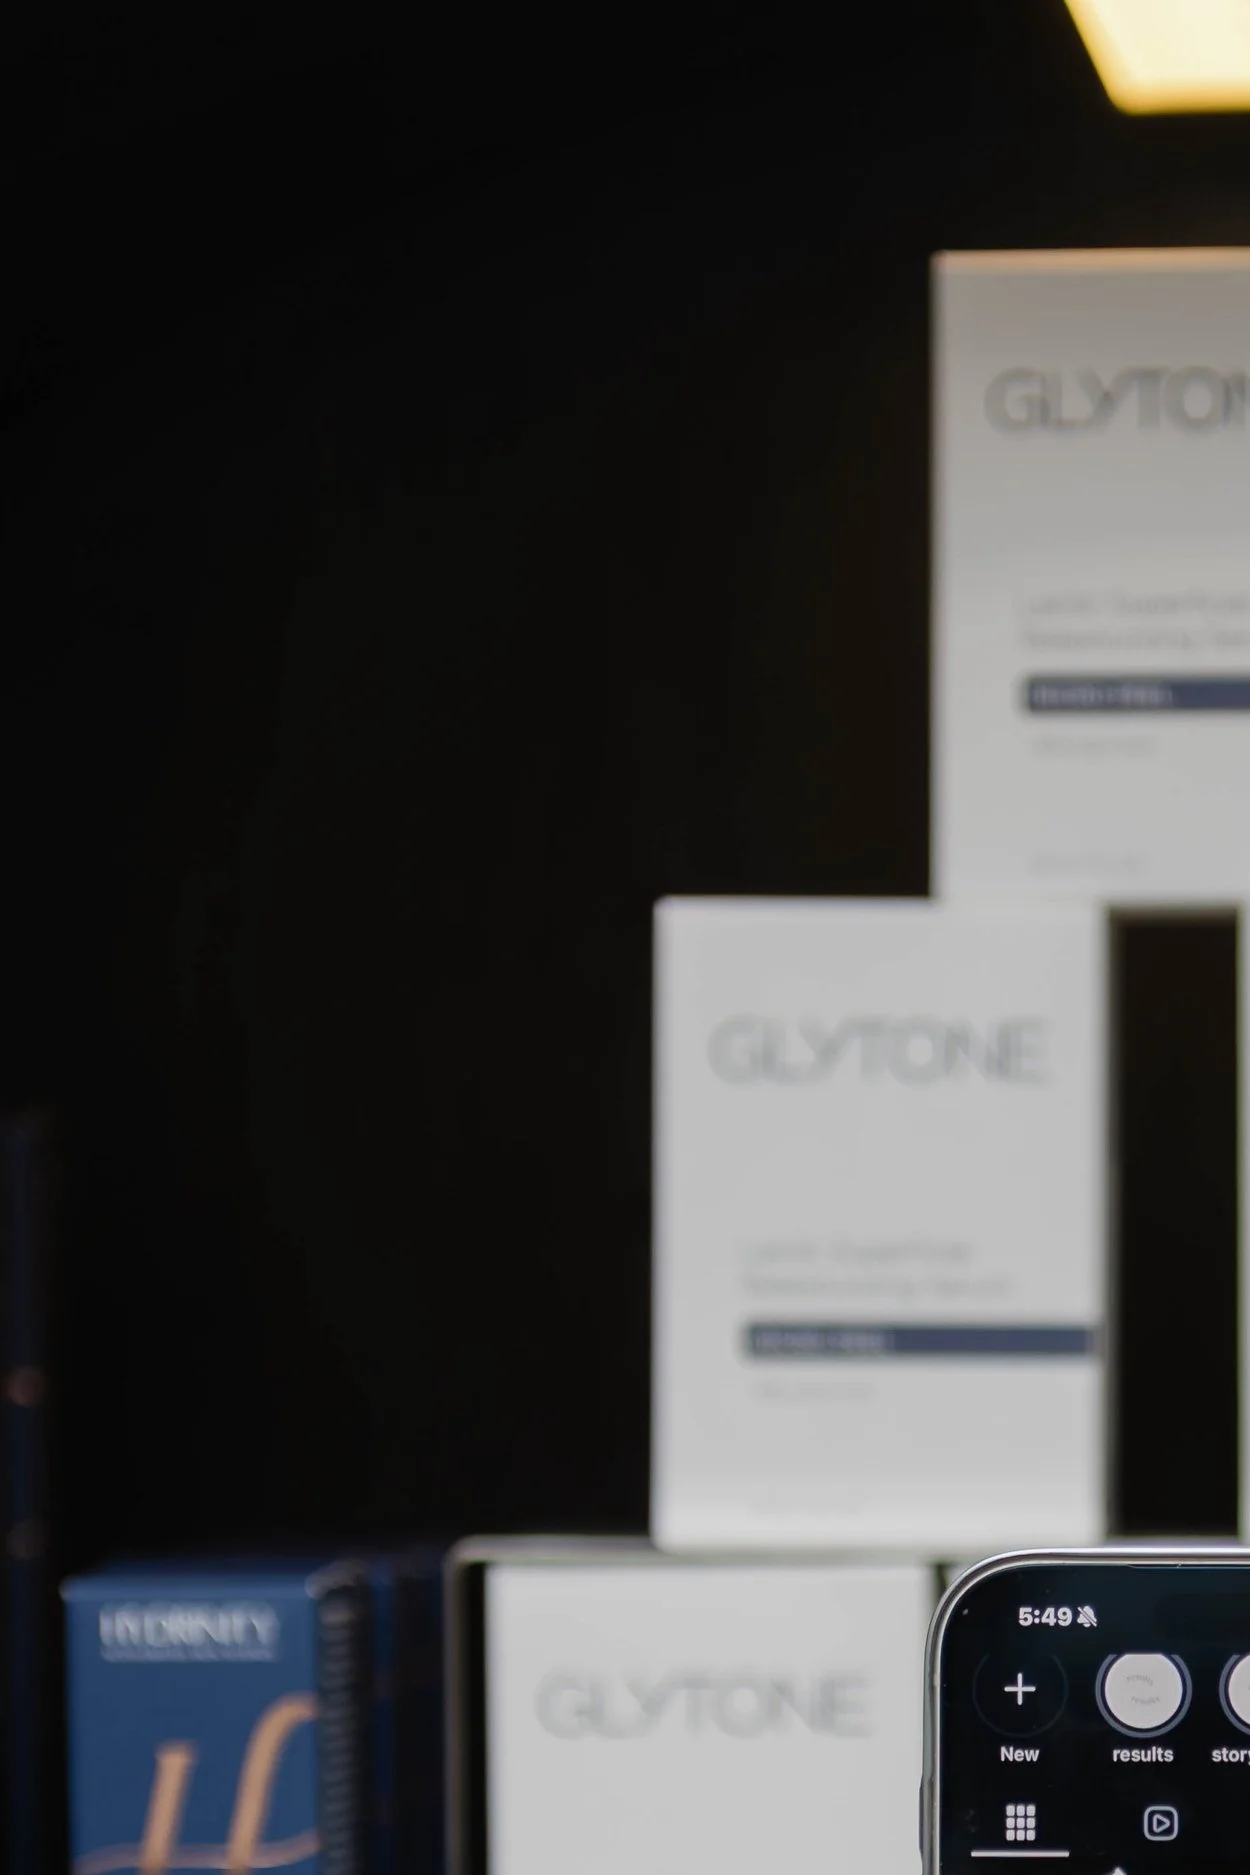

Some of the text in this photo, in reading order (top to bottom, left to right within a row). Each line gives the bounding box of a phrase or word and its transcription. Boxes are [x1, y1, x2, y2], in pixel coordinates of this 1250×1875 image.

[708, 1013, 1053, 1085] GLYTONE
[1019, 1606, 1073, 1627] 5:49
[537, 1666, 875, 1740] GLYTONE
[1000, 1746, 1040, 1763] New
[1112, 1746, 1174, 1763] results
